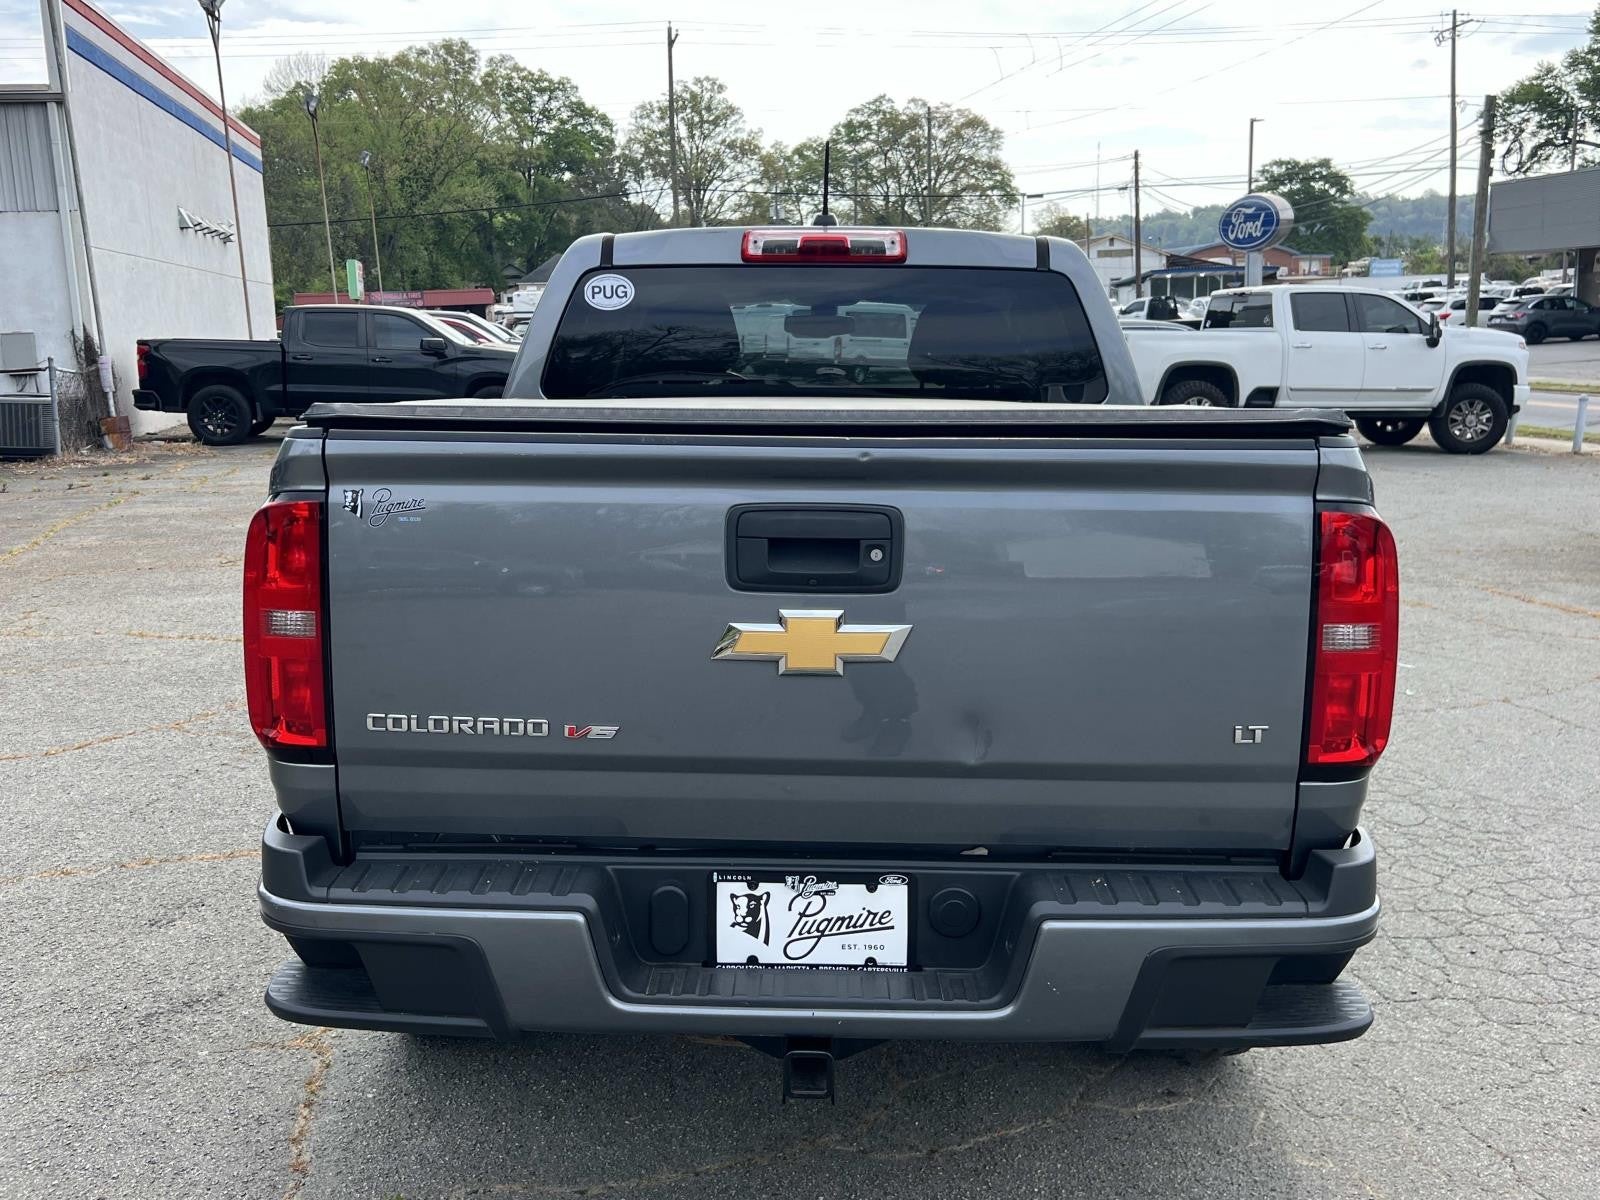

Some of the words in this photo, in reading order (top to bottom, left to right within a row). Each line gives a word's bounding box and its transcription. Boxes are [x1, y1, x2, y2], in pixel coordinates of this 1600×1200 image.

[1228, 206, 1265, 240] Ford
[591, 284, 628, 300] PUG
[369, 487, 426, 527] Pugmire
[366, 713, 549, 737] COLORADO
[563, 724, 621, 739] V6
[1234, 725, 1269, 744] LT
[783, 893, 895, 961] Pugmire
[841, 943, 861, 951] EST.
[863, 944, 885, 952] 1960
